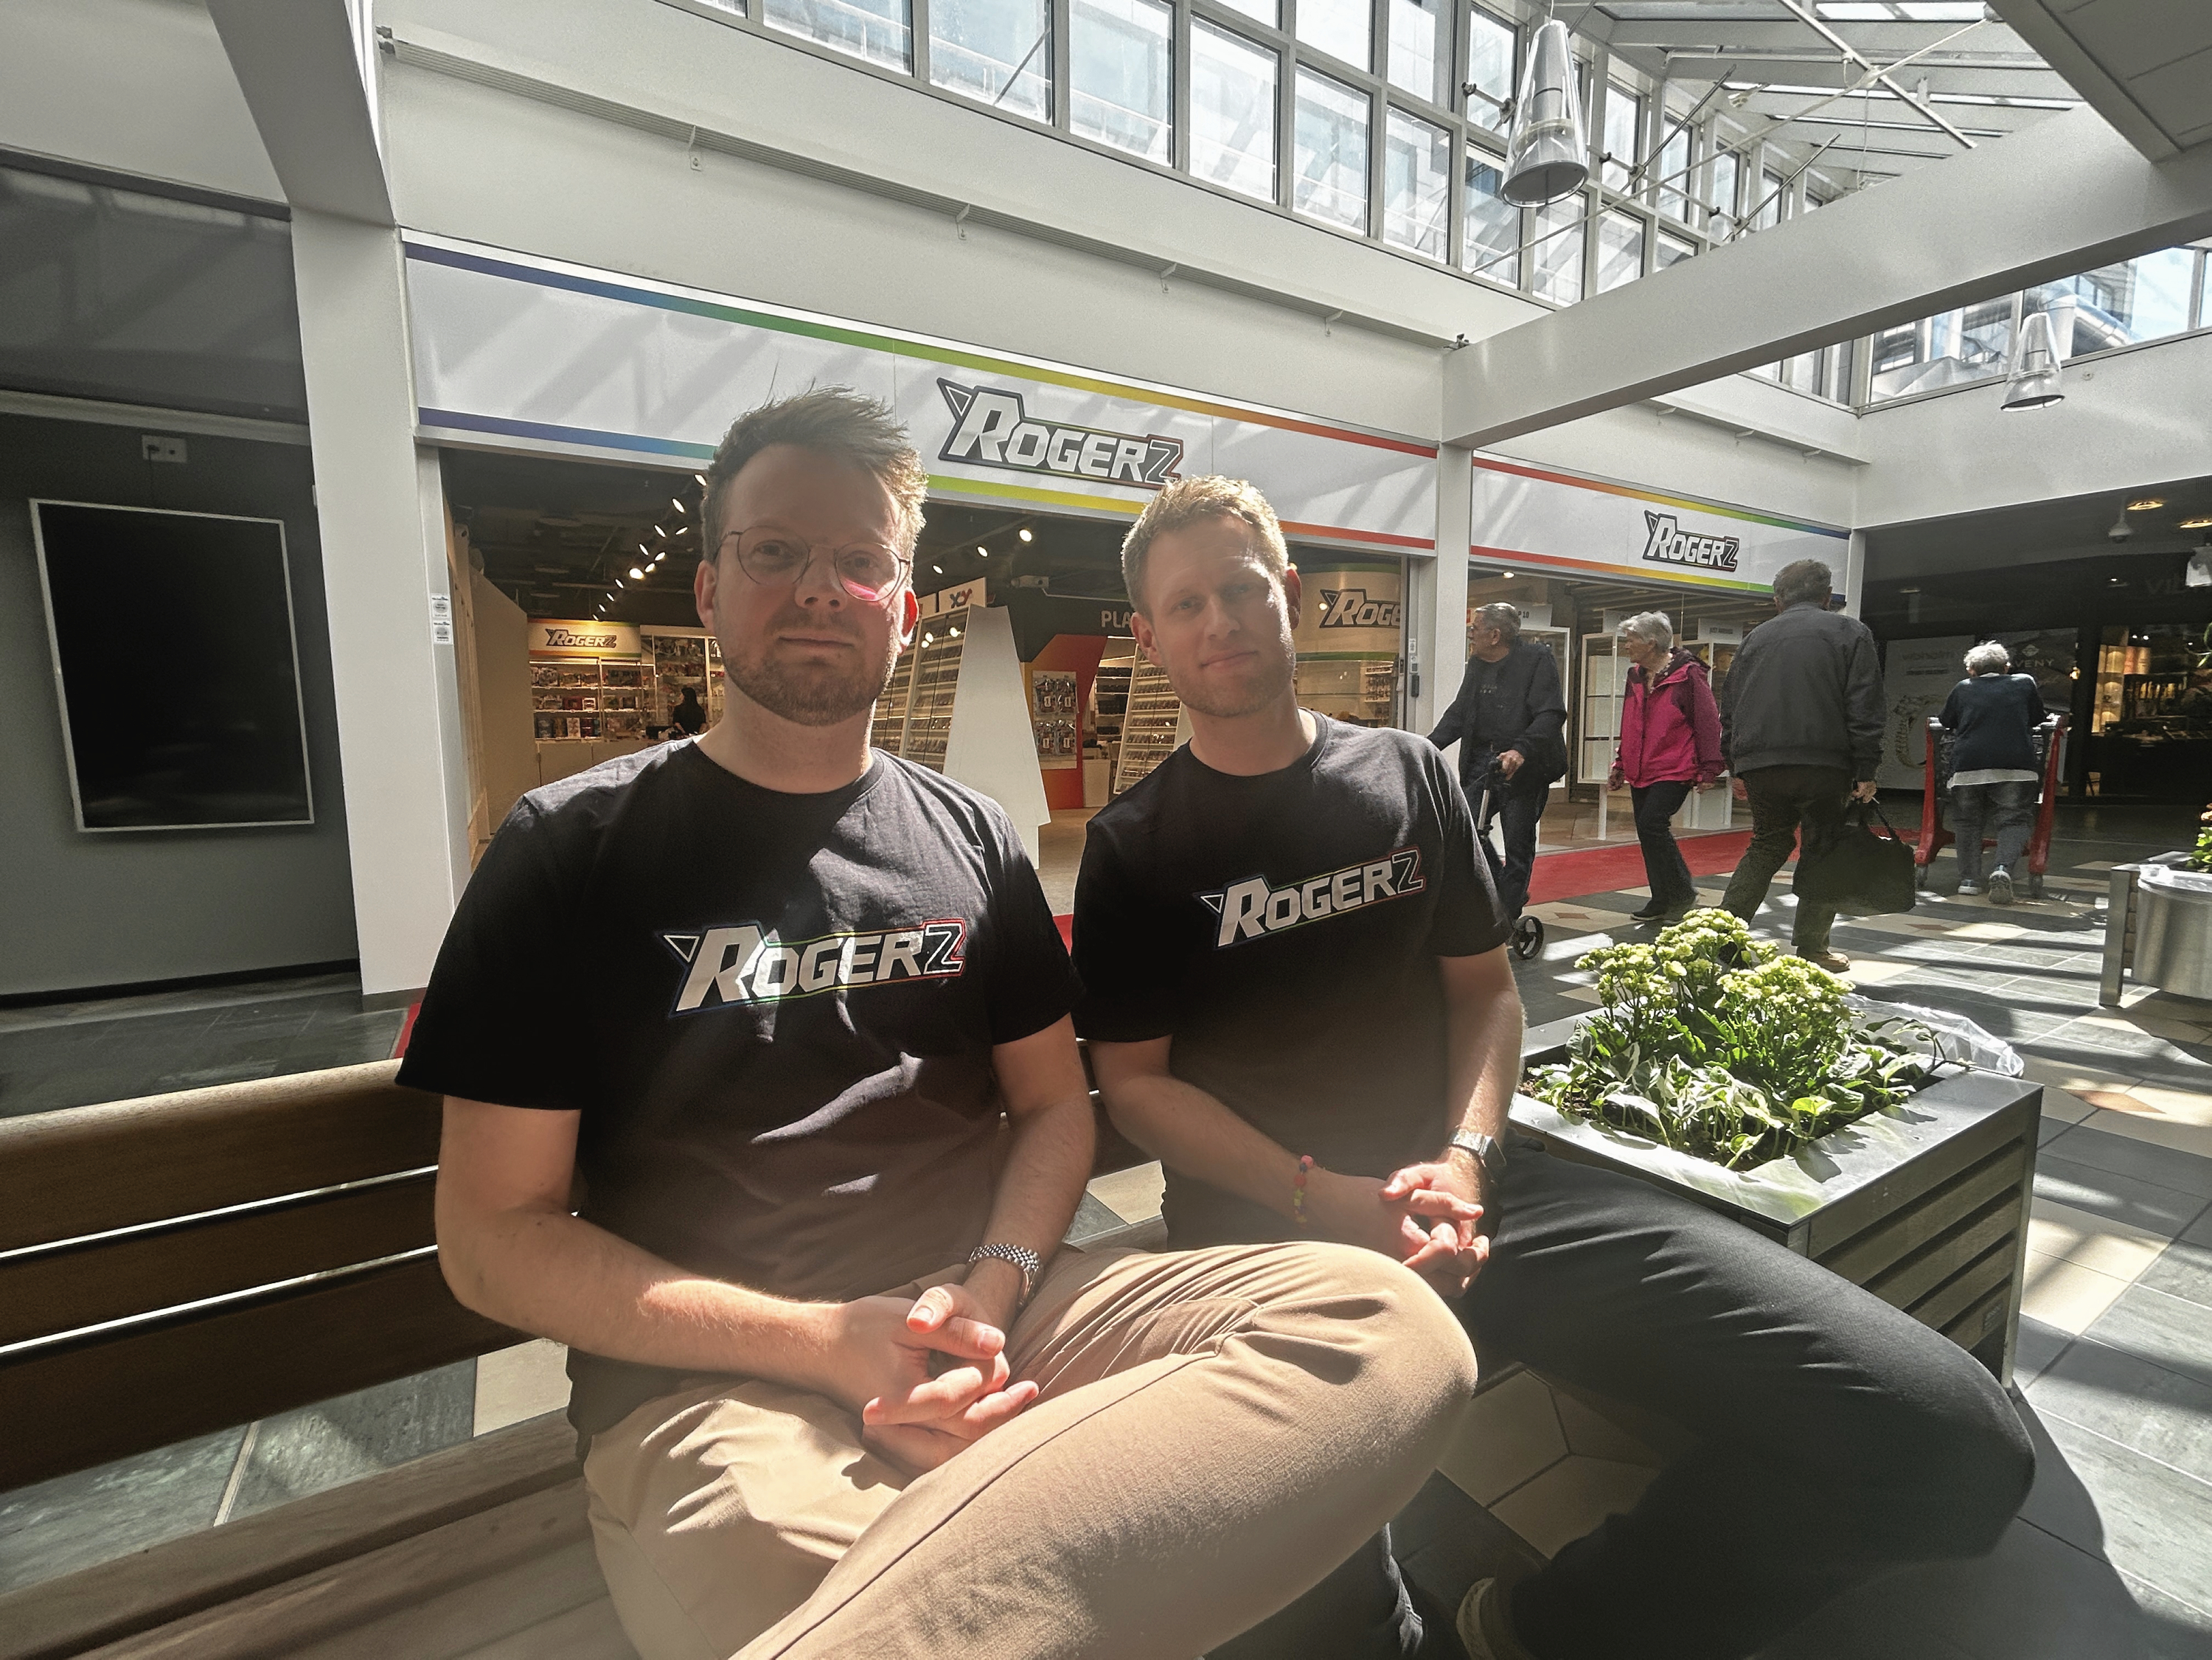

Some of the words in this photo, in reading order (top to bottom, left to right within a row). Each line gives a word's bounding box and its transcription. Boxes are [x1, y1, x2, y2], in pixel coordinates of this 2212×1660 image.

[946, 391, 1182, 486] ROGERZ
[1646, 515, 1739, 569] ROGERZ
[1101, 610, 1132, 628] PLA
[1324, 591, 1400, 626] ROGE
[547, 629, 616, 647] ROGERZ
[1215, 849, 1425, 948] ROGERZ
[673, 923, 964, 1013] ROGERZ
